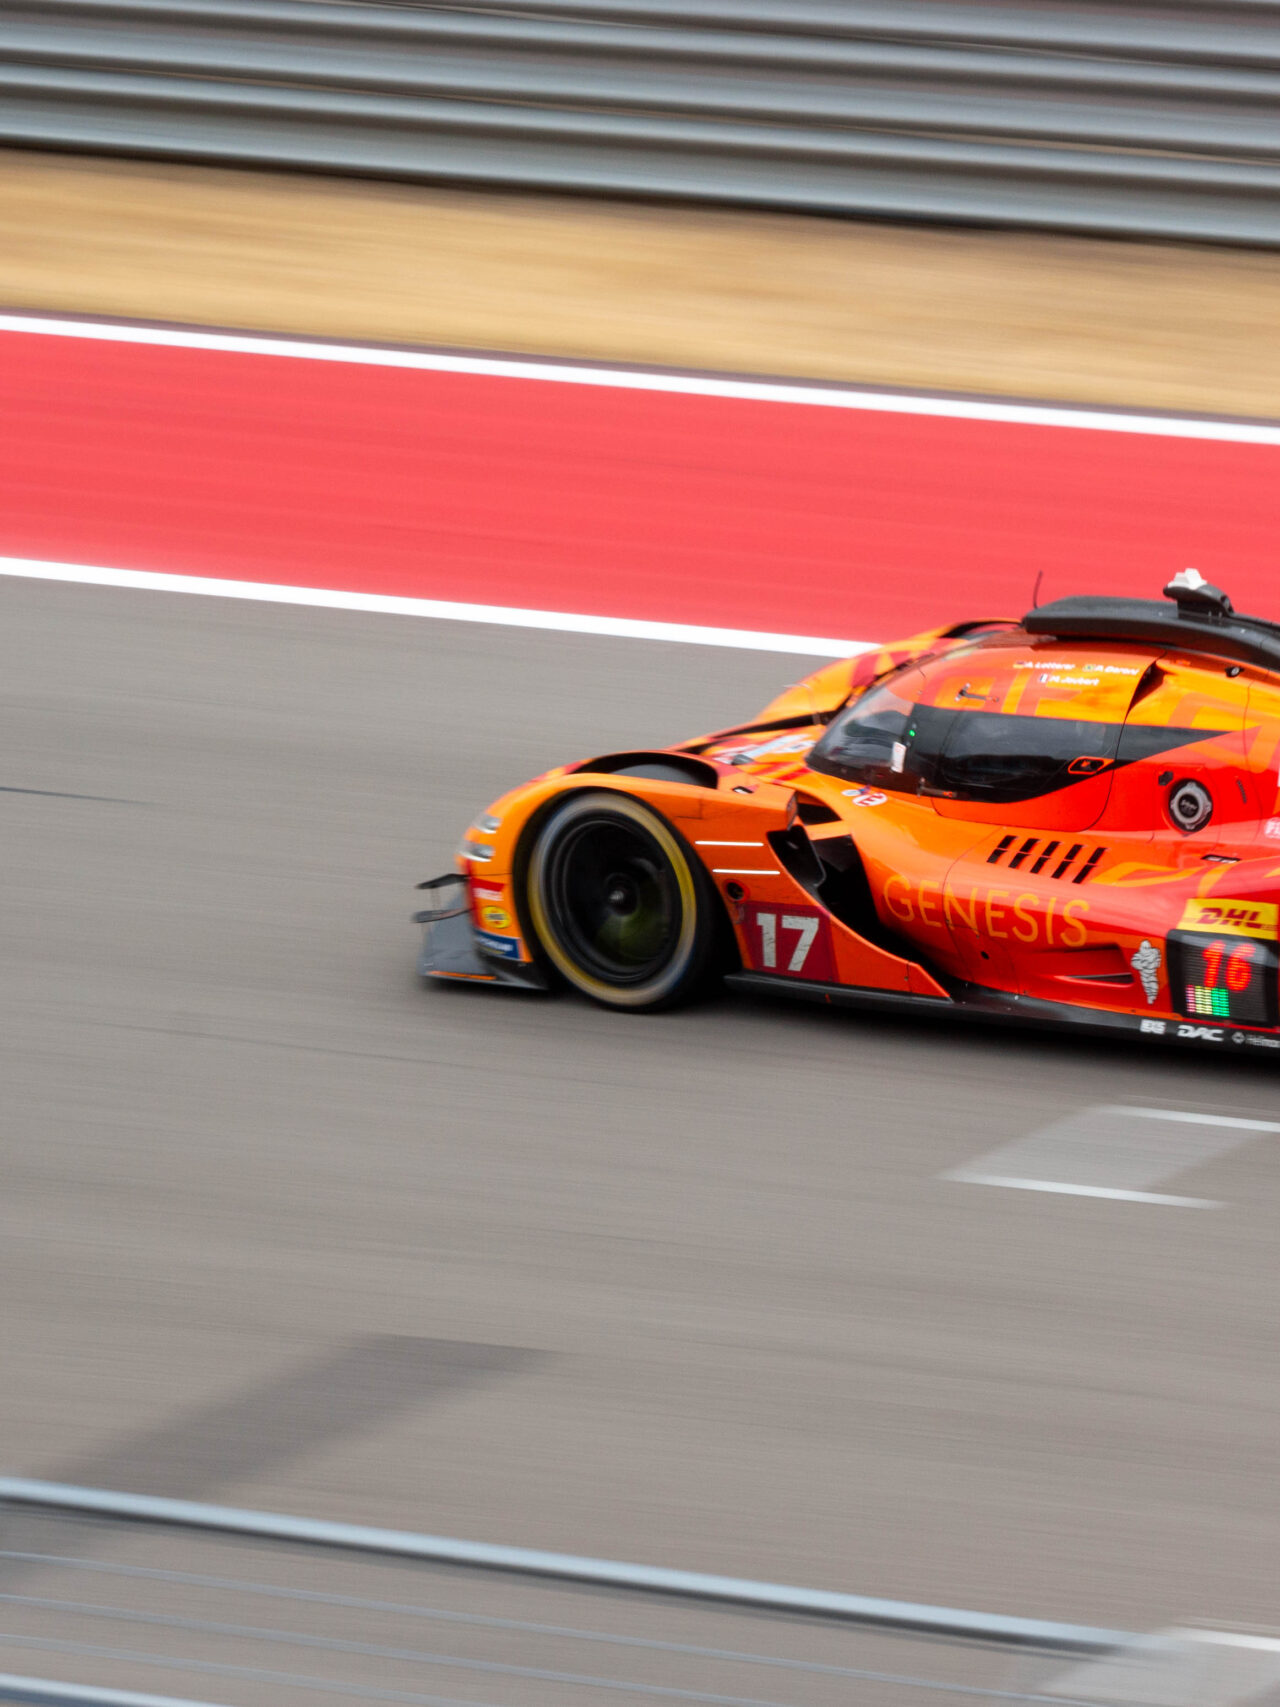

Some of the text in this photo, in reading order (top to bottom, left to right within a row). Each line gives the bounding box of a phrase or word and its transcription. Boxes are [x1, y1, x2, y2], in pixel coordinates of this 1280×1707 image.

[884, 874, 1089, 947] GENESIS
[1197, 907, 1262, 929] DHL
[756, 912, 819, 972] 17
[1202, 940, 1256, 992] 16
[1177, 1024, 1224, 1042] DAC
